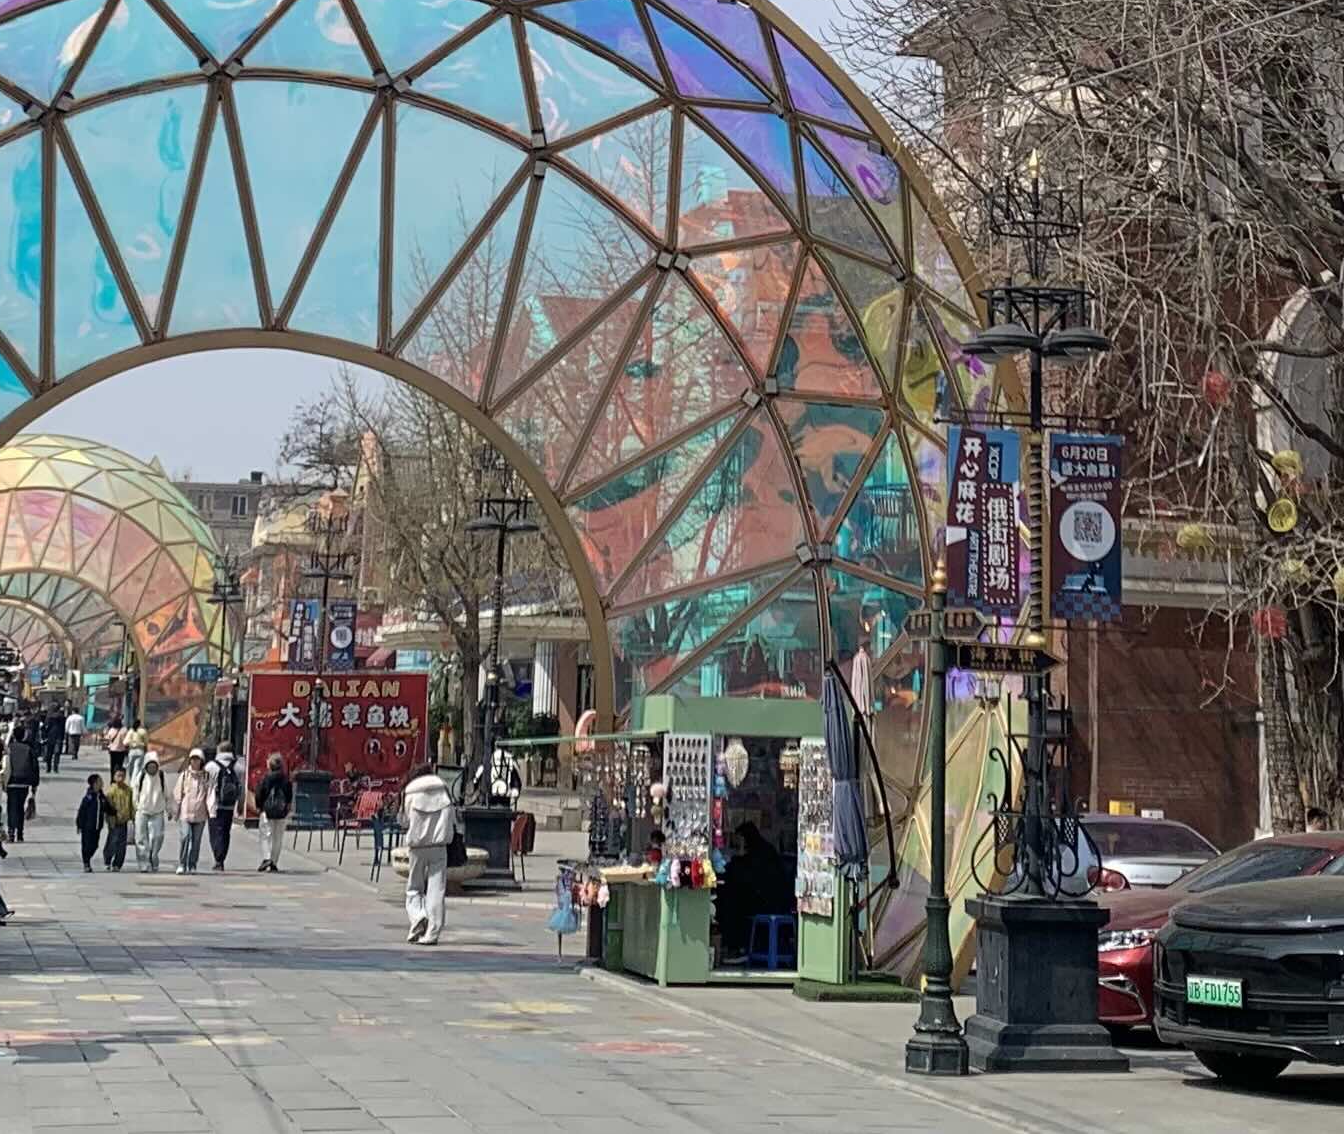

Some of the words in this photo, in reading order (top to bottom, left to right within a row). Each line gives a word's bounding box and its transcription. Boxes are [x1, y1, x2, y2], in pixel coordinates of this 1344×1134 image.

[956, 437, 983, 524] 开心麻花
[1061, 446, 1108, 462] 6月20日
[986, 496, 1010, 592] 俄街剧场
